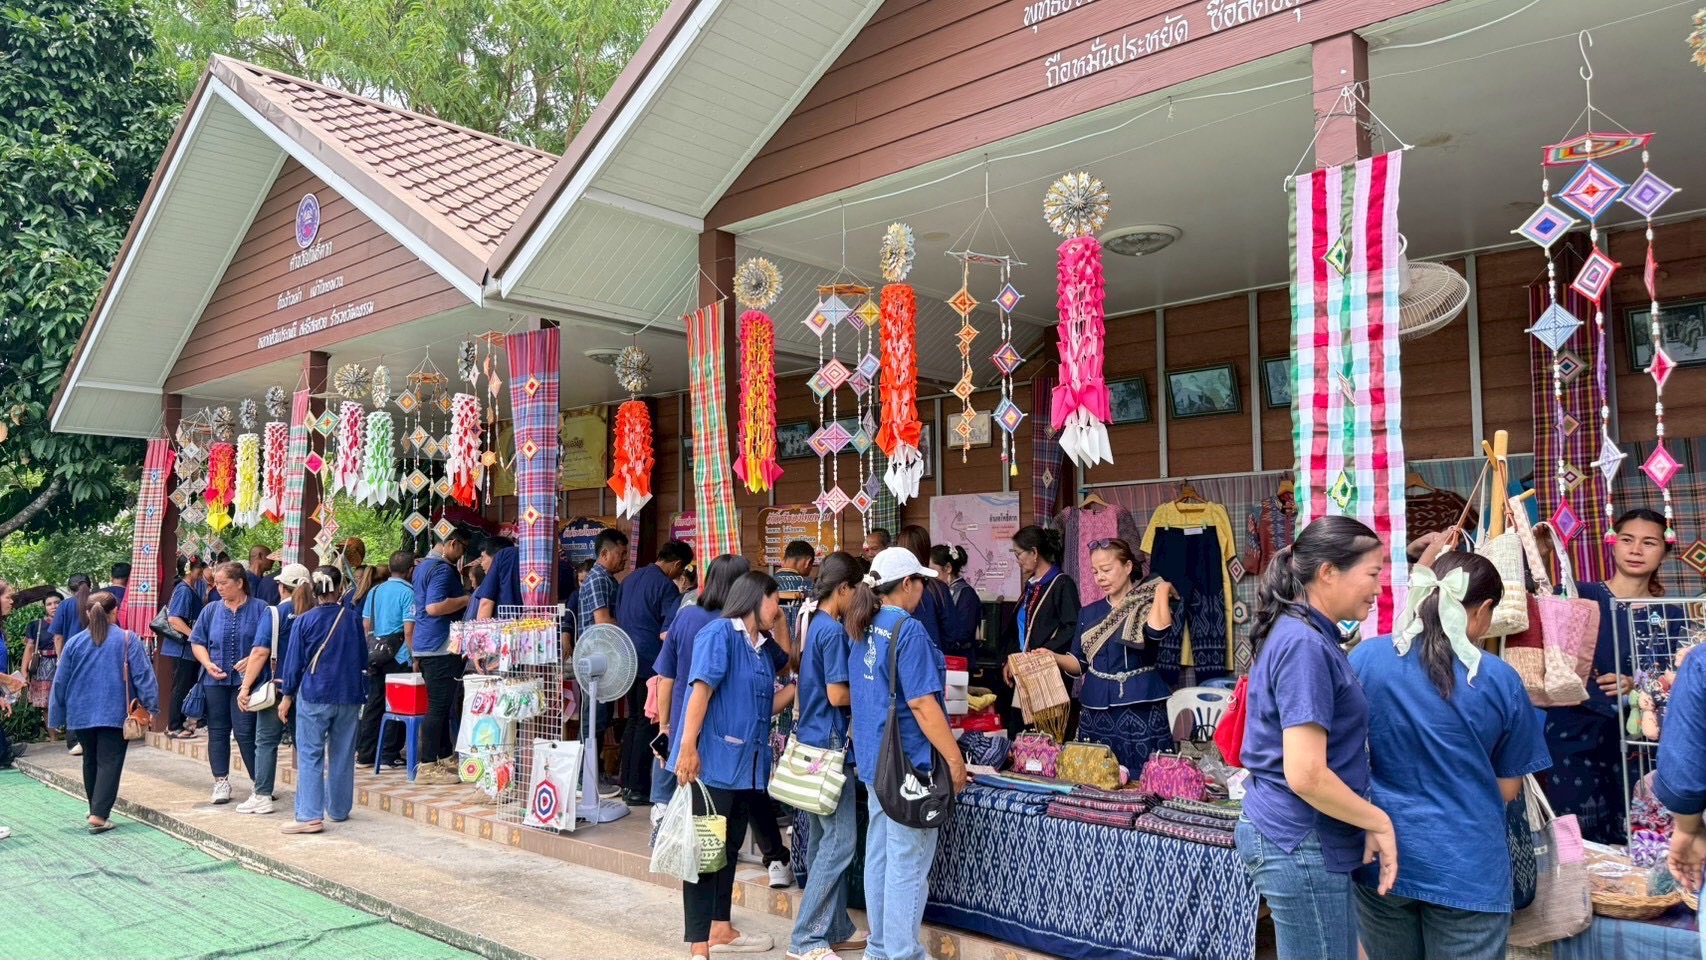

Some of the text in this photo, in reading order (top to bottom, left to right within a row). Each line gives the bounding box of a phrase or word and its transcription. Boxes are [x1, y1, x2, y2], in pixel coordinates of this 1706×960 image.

[1044, 14, 1189, 88] ถือหมั่นประหยัด
